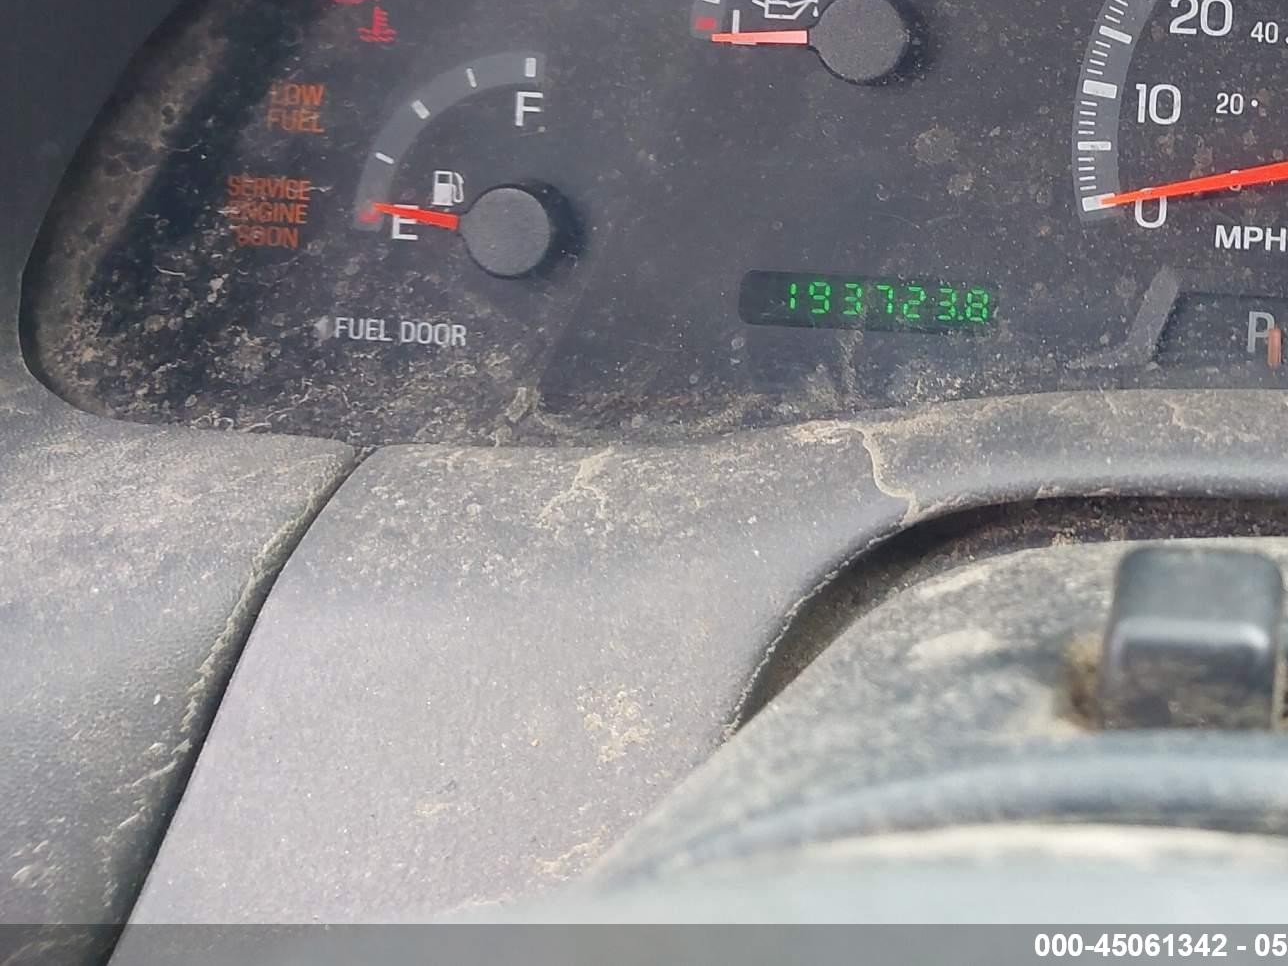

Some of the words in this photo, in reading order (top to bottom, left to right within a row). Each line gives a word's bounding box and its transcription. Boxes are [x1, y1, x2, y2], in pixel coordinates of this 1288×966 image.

[1250, 21, 1280, 44] 40
[270, 81, 324, 107] LOW
[1135, 83, 1182, 125] 10
[1215, 93, 1245, 115] 20
[266, 108, 325, 133] FUEL
[515, 91, 543, 126] F
[228, 174, 311, 201] SERVICE
[229, 200, 309, 224] ENGINE
[392, 204, 418, 240] E
[1134, 187, 1167, 229] 0
[1214, 224, 1287, 252] MPH
[335, 317, 393, 343] FUEL
[401, 321, 467, 347] DOOR
[1247, 311, 1276, 353] P
